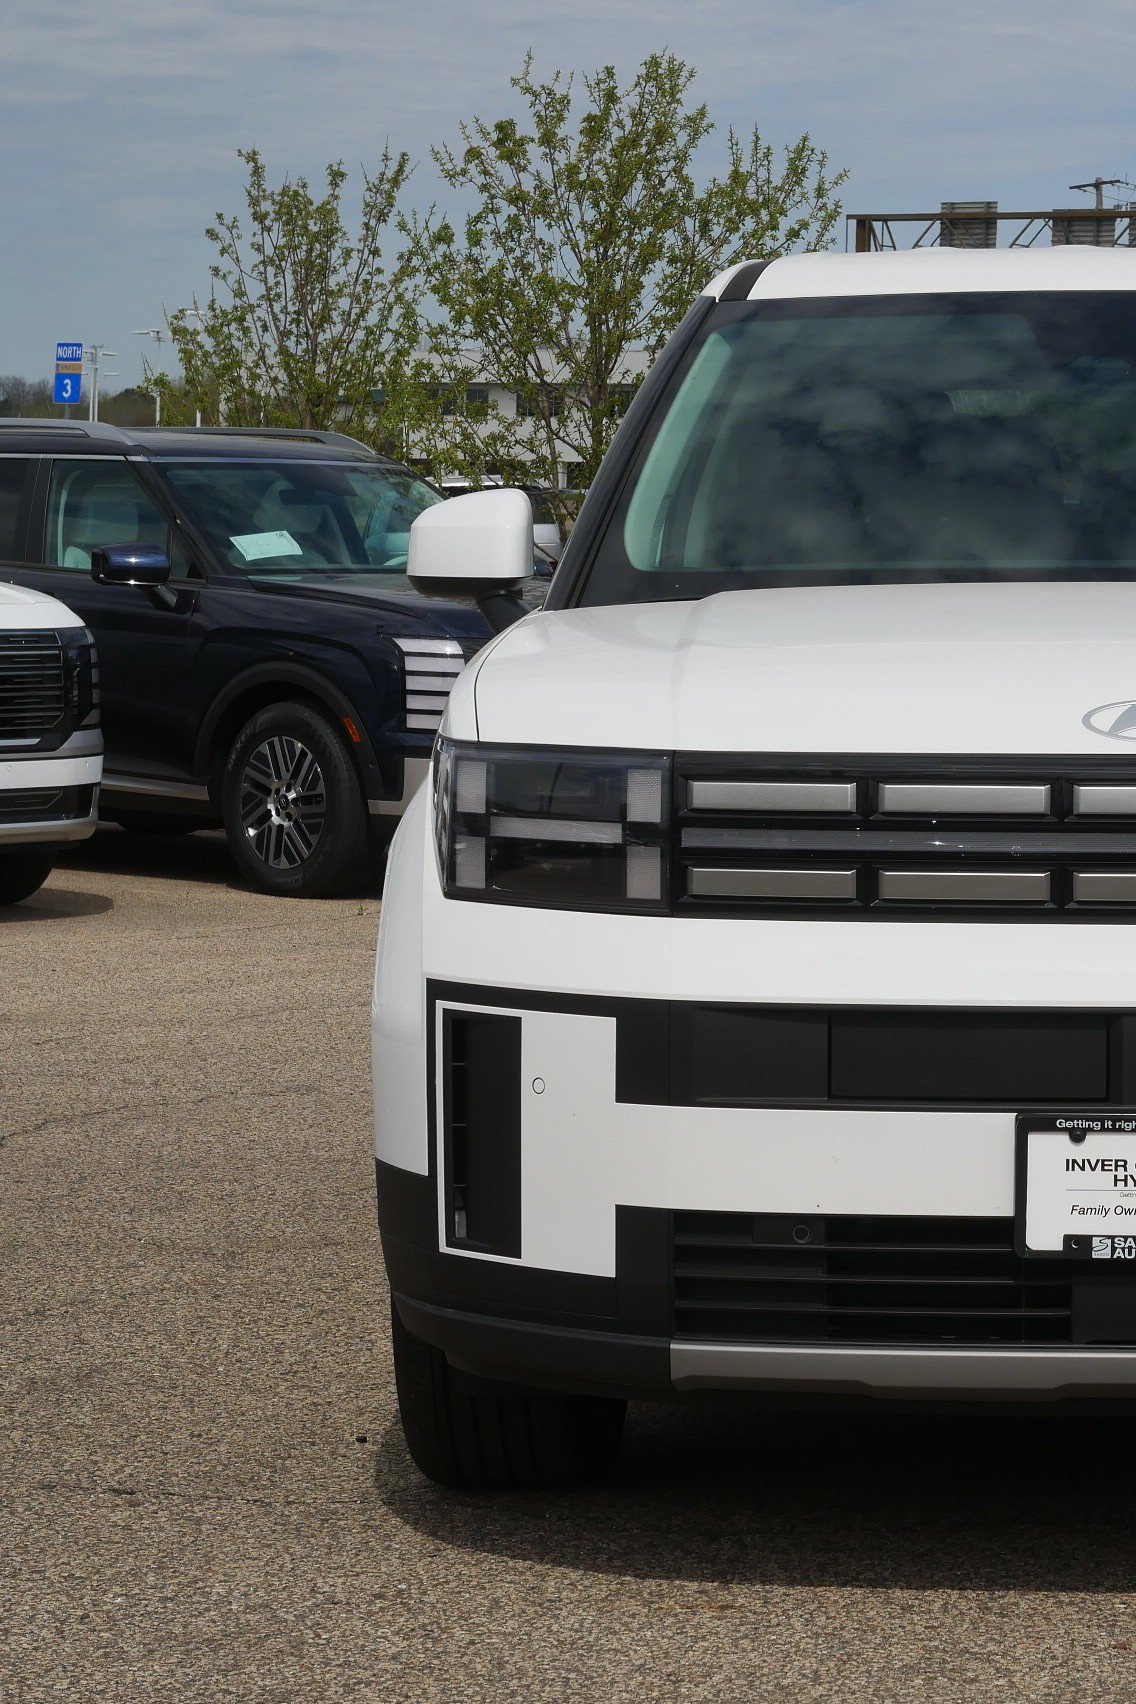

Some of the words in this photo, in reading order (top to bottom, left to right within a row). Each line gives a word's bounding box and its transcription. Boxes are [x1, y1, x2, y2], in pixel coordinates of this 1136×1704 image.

[57, 346, 82, 358] NORTH
[62, 379, 71, 398] 3
[1056, 1119, 1101, 1130] Getting
[1104, 1120, 1113, 1129] it
[1065, 1159, 1128, 1172] INVER
[1070, 1204, 1111, 1218] Family
